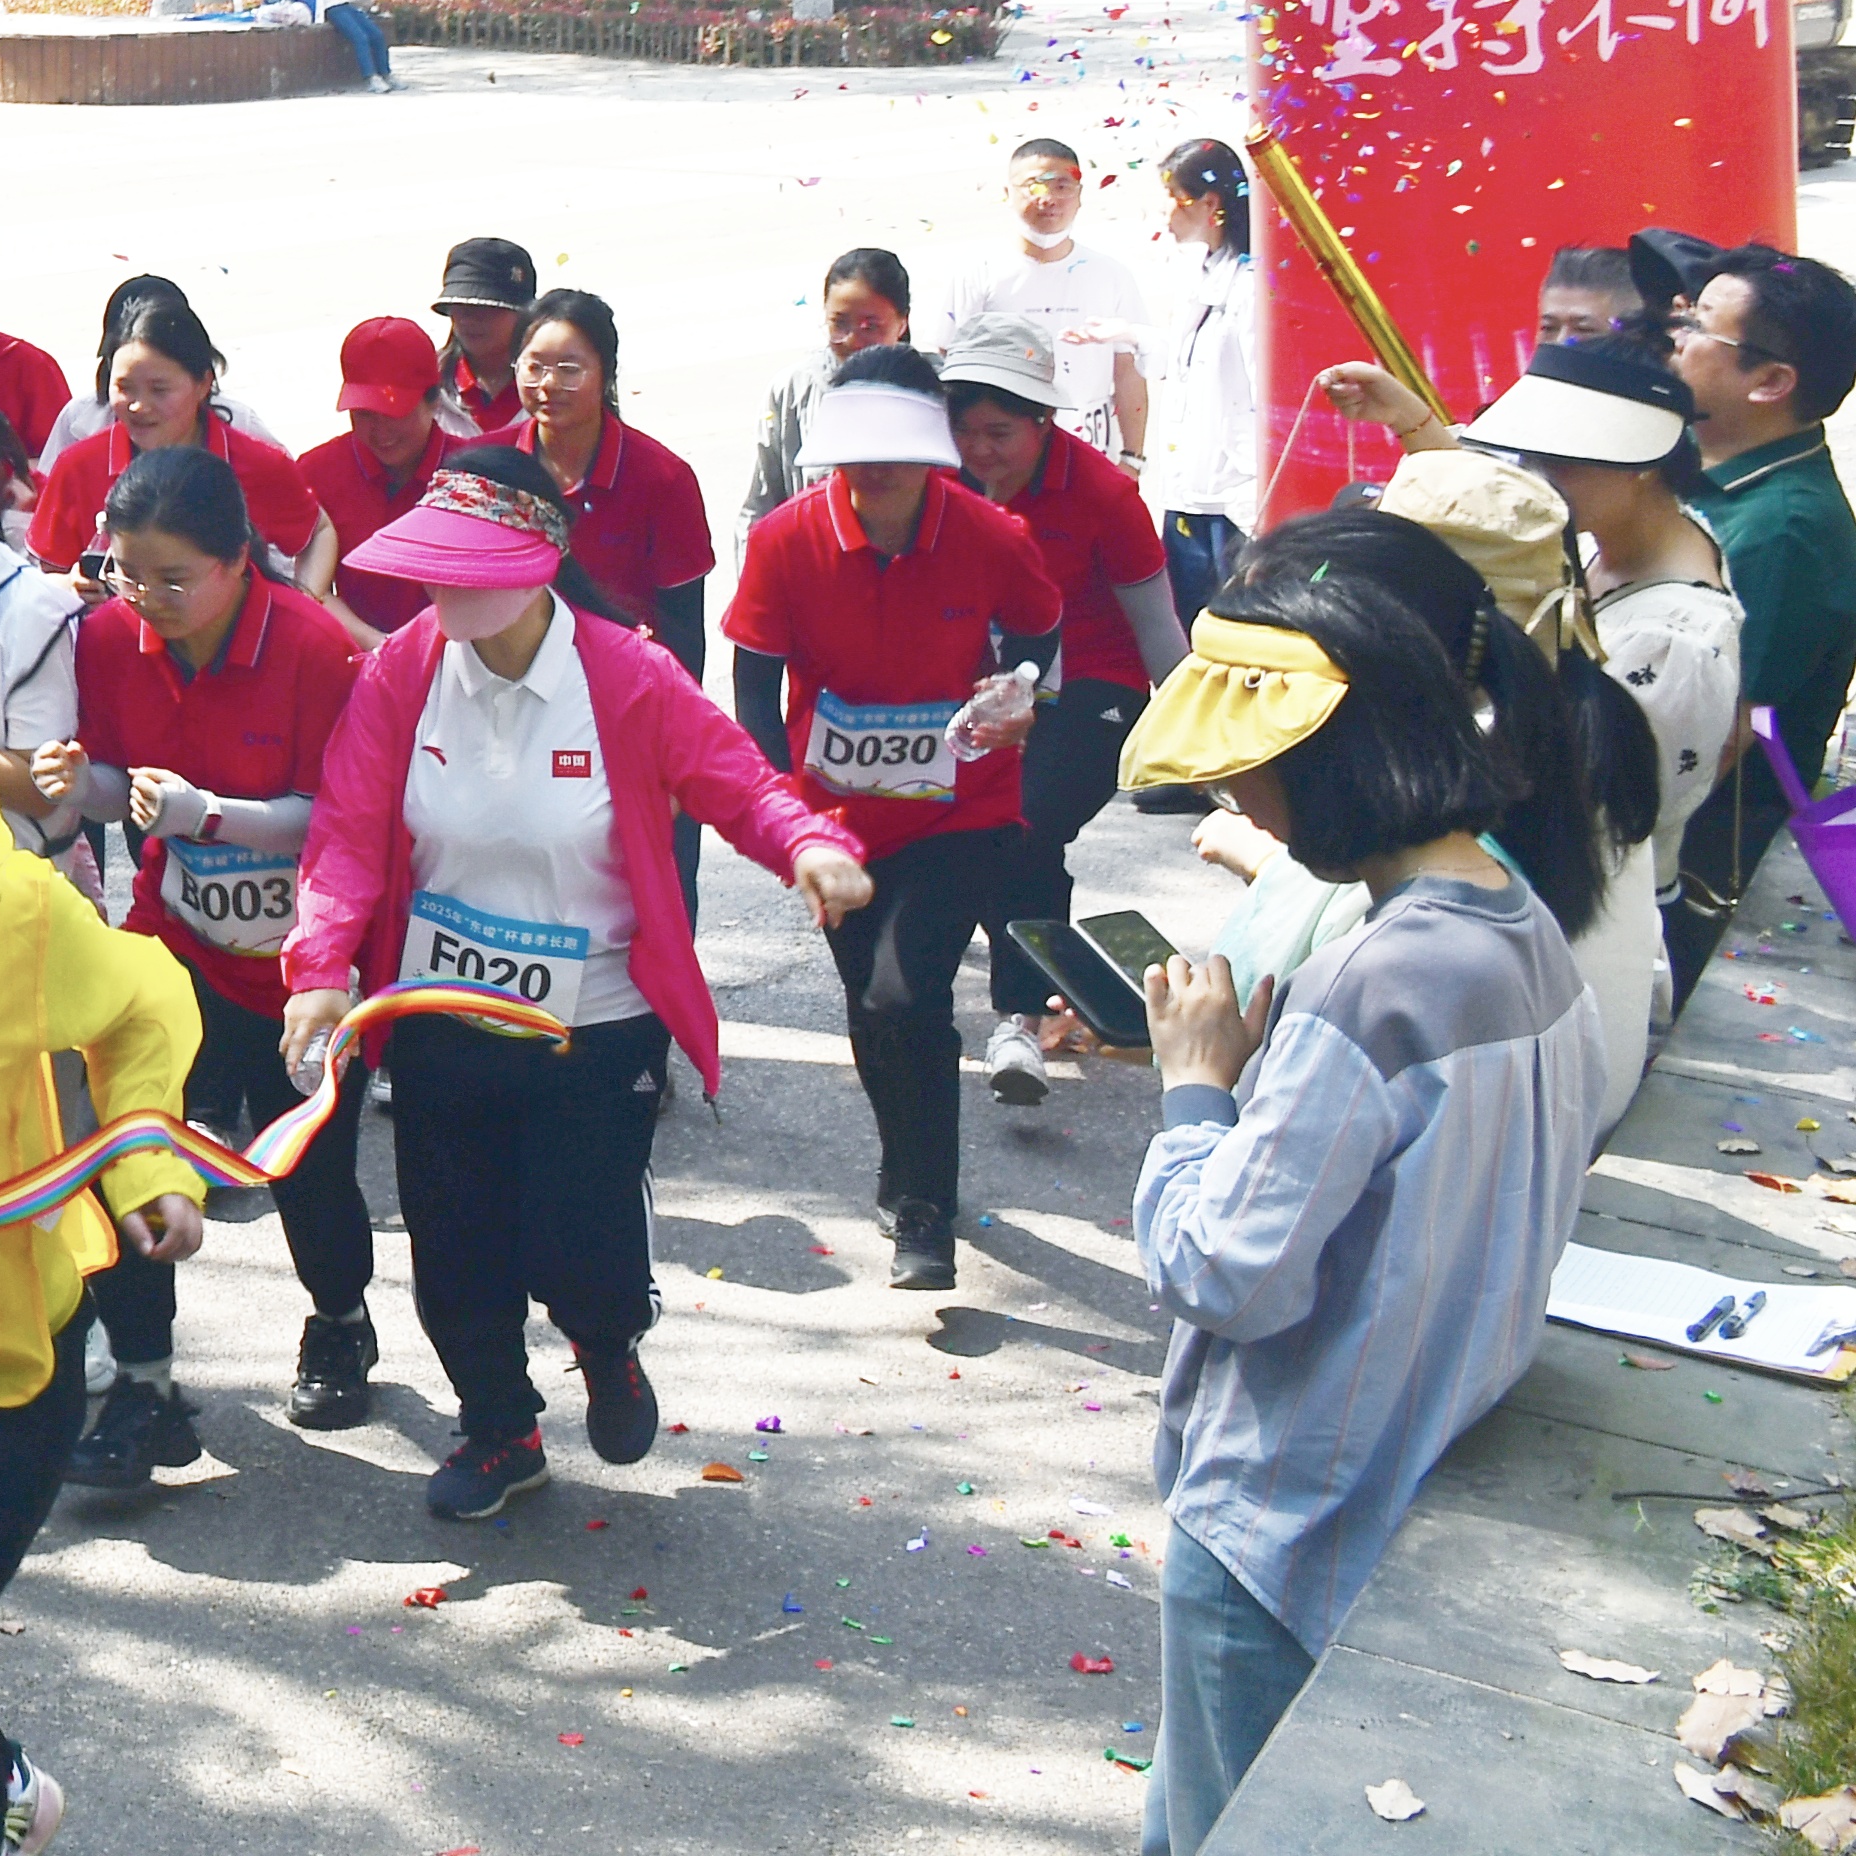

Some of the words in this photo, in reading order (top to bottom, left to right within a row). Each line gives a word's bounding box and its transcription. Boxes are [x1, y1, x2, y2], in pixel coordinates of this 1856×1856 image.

[558, 754, 586, 768] 中国
[823, 728, 937, 767] D030
[180, 867, 292, 922] B003
[429, 930, 552, 1003] F020
